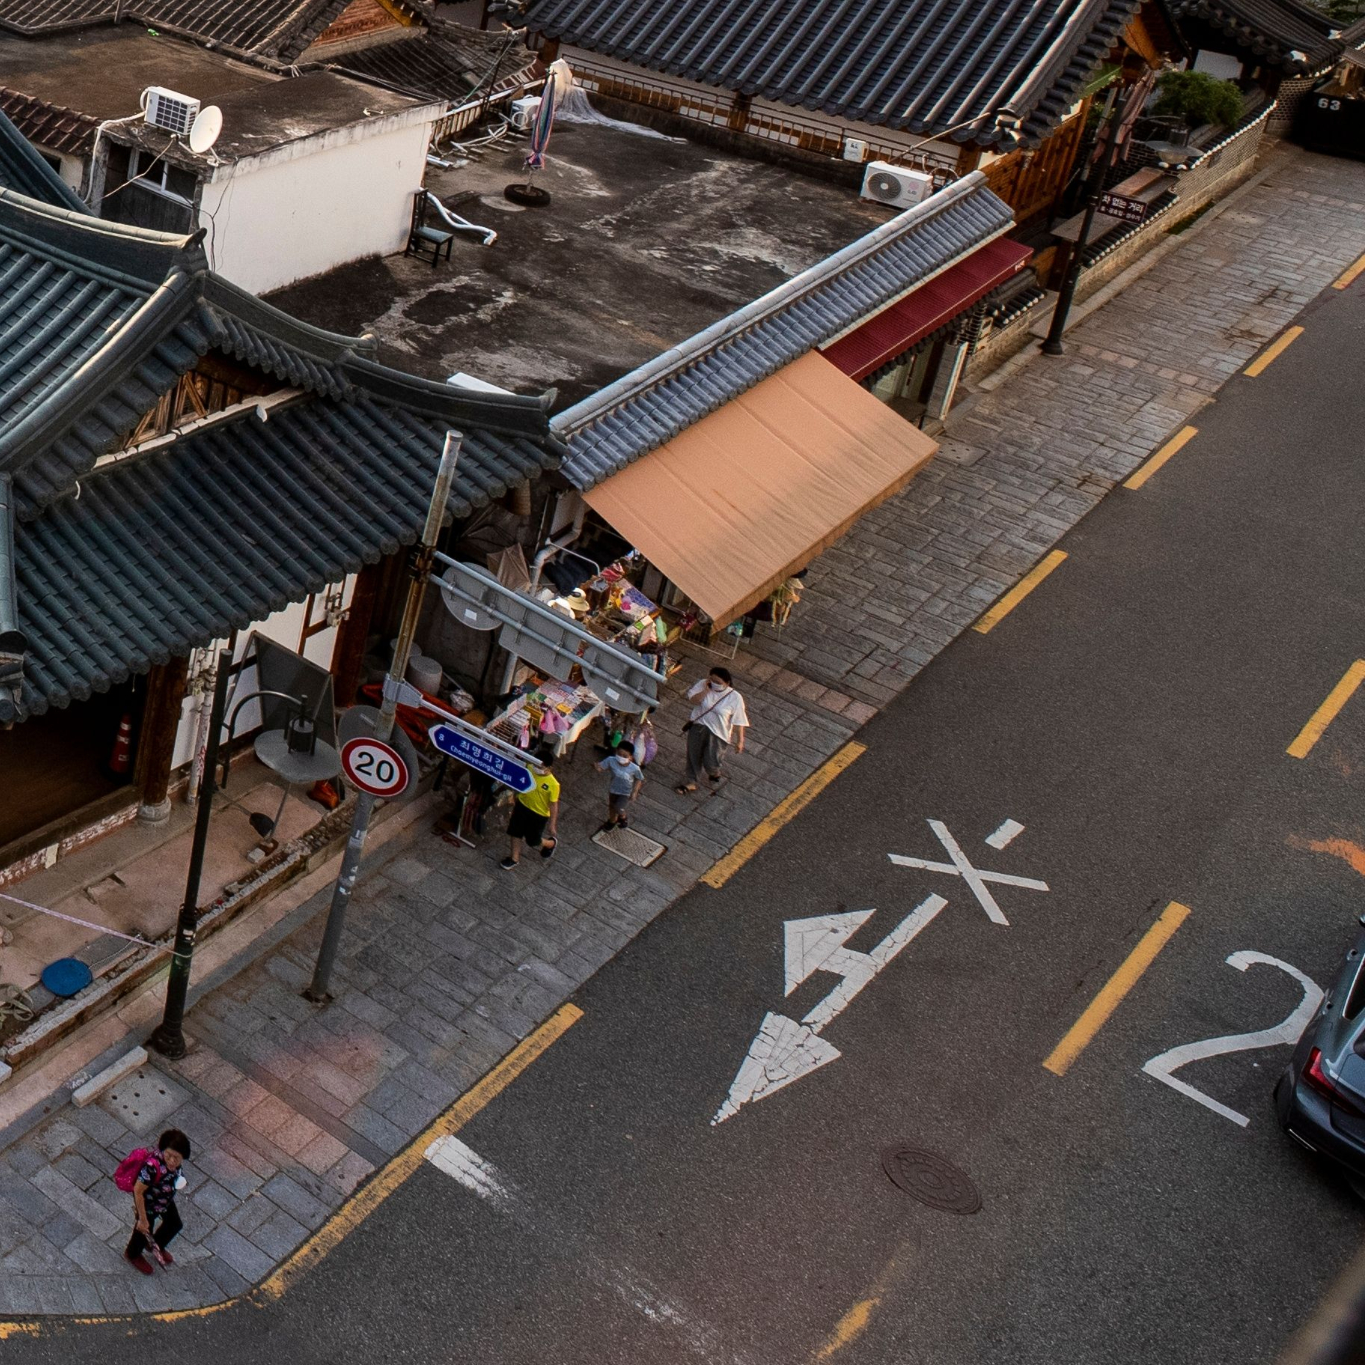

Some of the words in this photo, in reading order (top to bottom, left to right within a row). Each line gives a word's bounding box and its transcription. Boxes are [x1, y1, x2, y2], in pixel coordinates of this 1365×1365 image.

[1317, 97, 1341, 111] 63
[1127, 201, 1145, 214] 거리
[438, 733, 445, 742] 8
[354, 751, 395, 783] 20
[518, 776, 526, 785] 4
